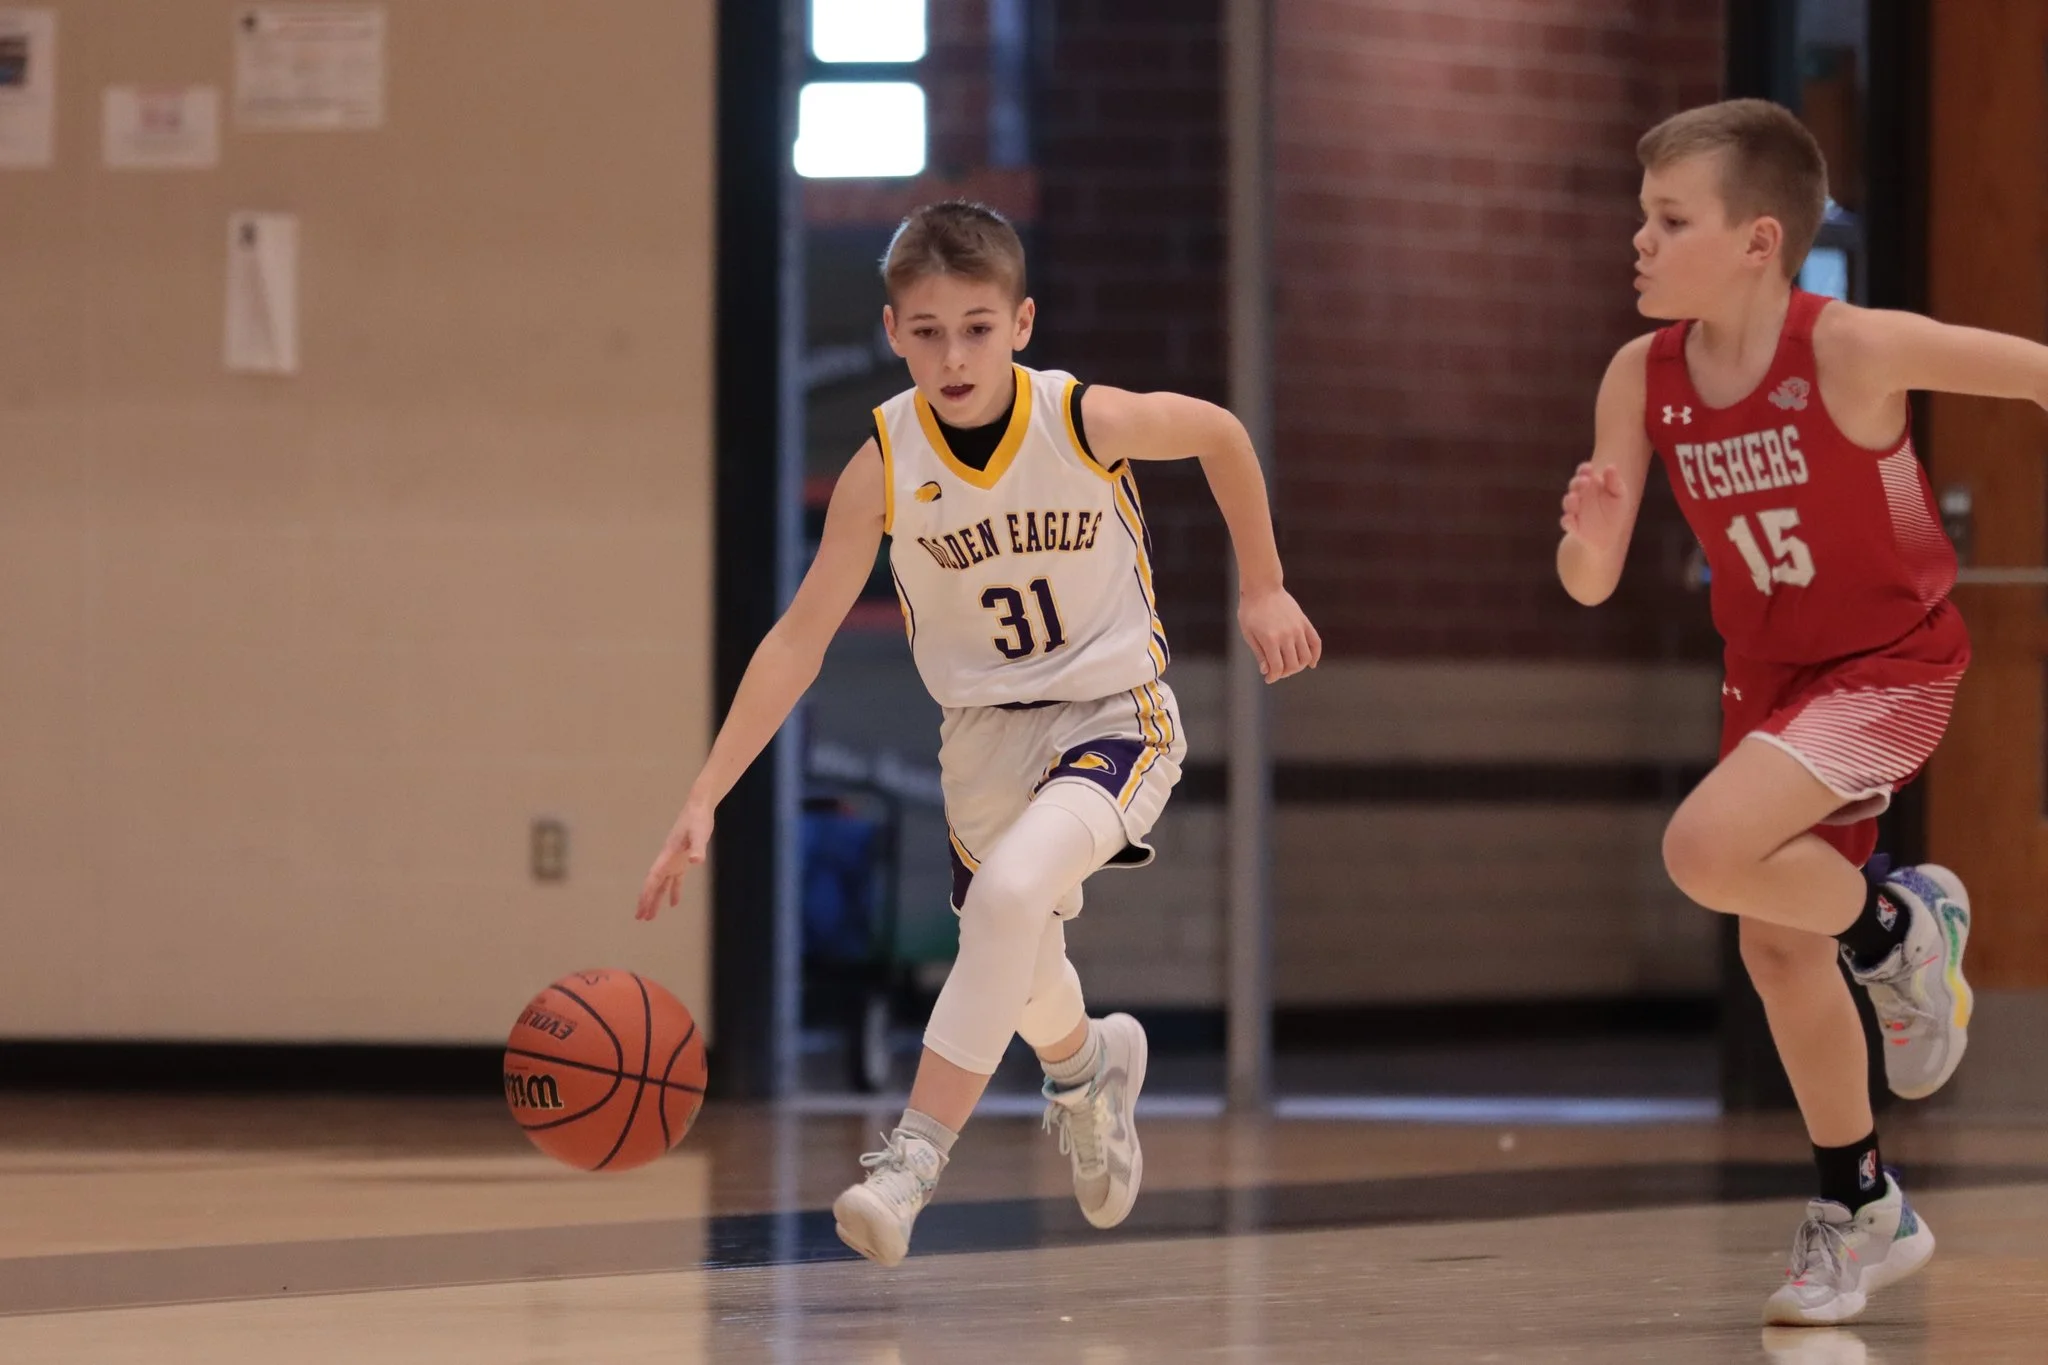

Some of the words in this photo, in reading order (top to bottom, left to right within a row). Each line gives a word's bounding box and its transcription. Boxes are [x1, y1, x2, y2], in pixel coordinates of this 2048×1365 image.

[1675, 424, 1810, 500] FISHERS
[1006, 511, 1103, 553] EAGLES
[1725, 507, 1817, 596] 15
[979, 576, 1067, 661] 31
